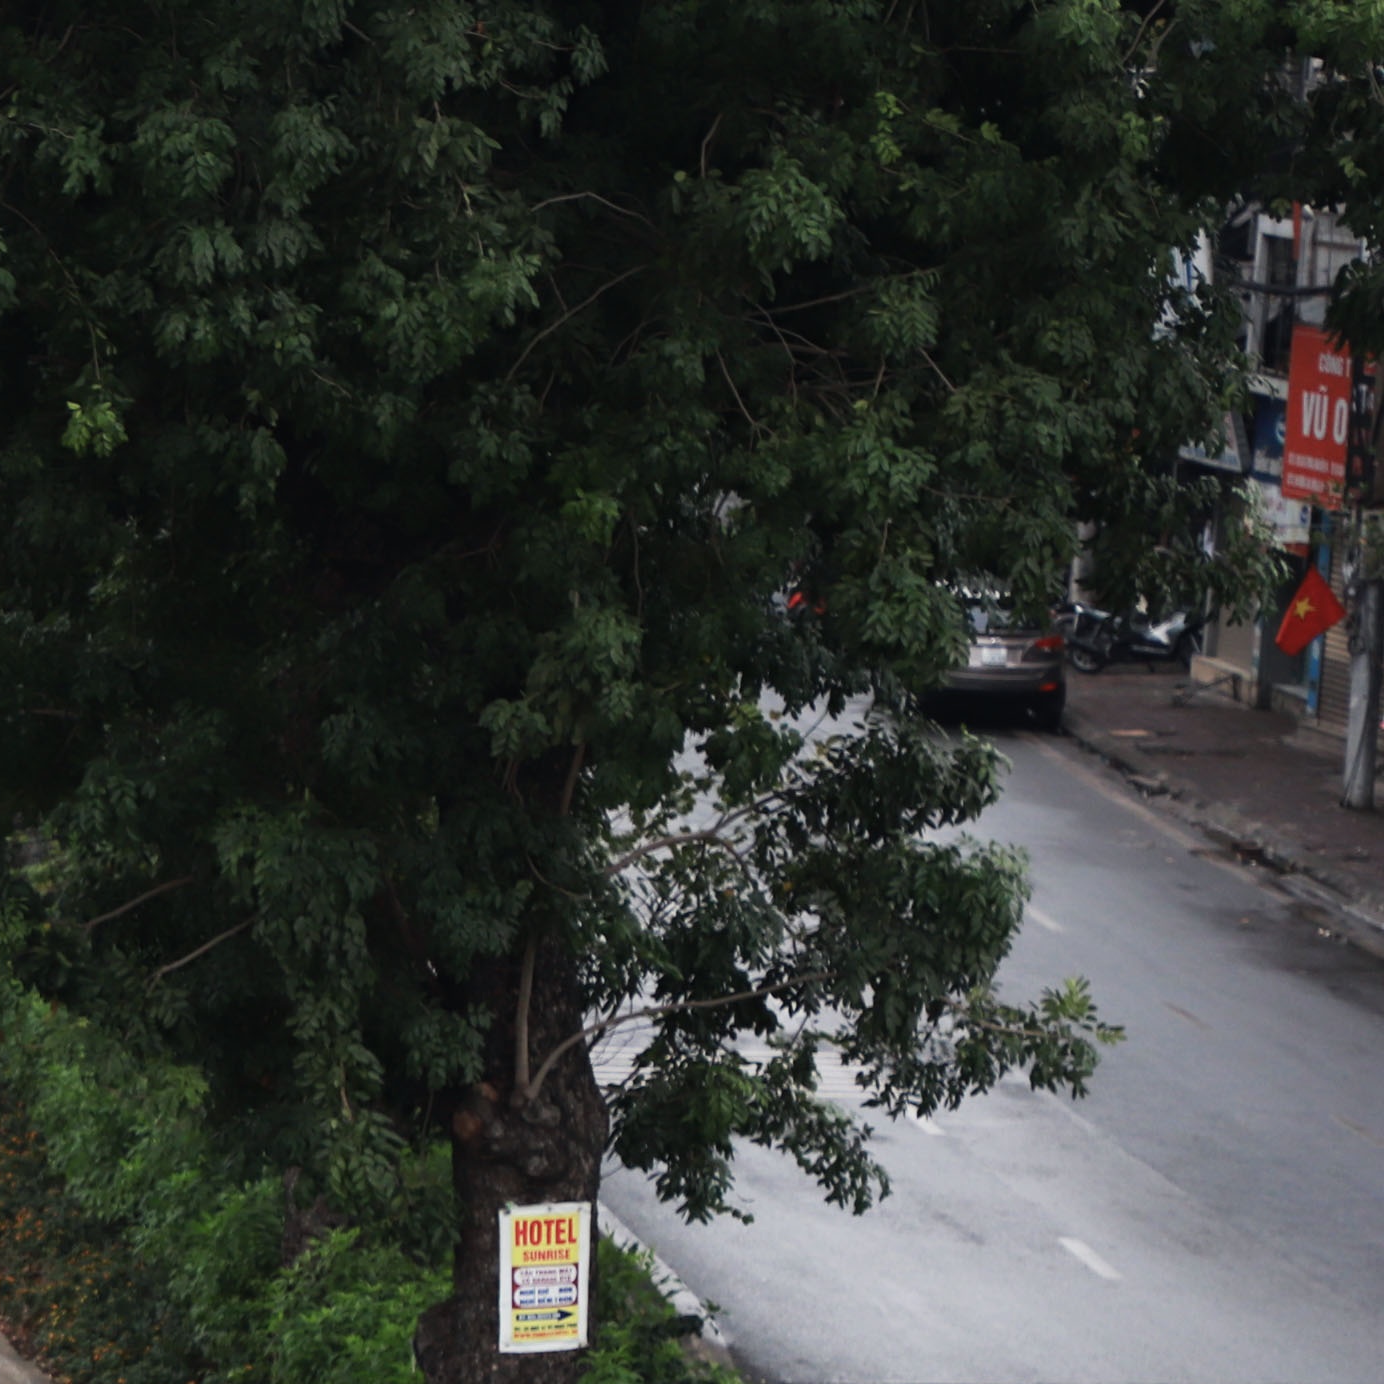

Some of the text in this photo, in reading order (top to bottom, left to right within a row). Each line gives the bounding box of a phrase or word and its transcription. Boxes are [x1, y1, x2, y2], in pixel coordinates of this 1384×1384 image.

[1303, 385, 1328, 440] VŨ
[515, 1218, 576, 1246] HOTEL
[523, 1249, 569, 1262] SUNRISE
